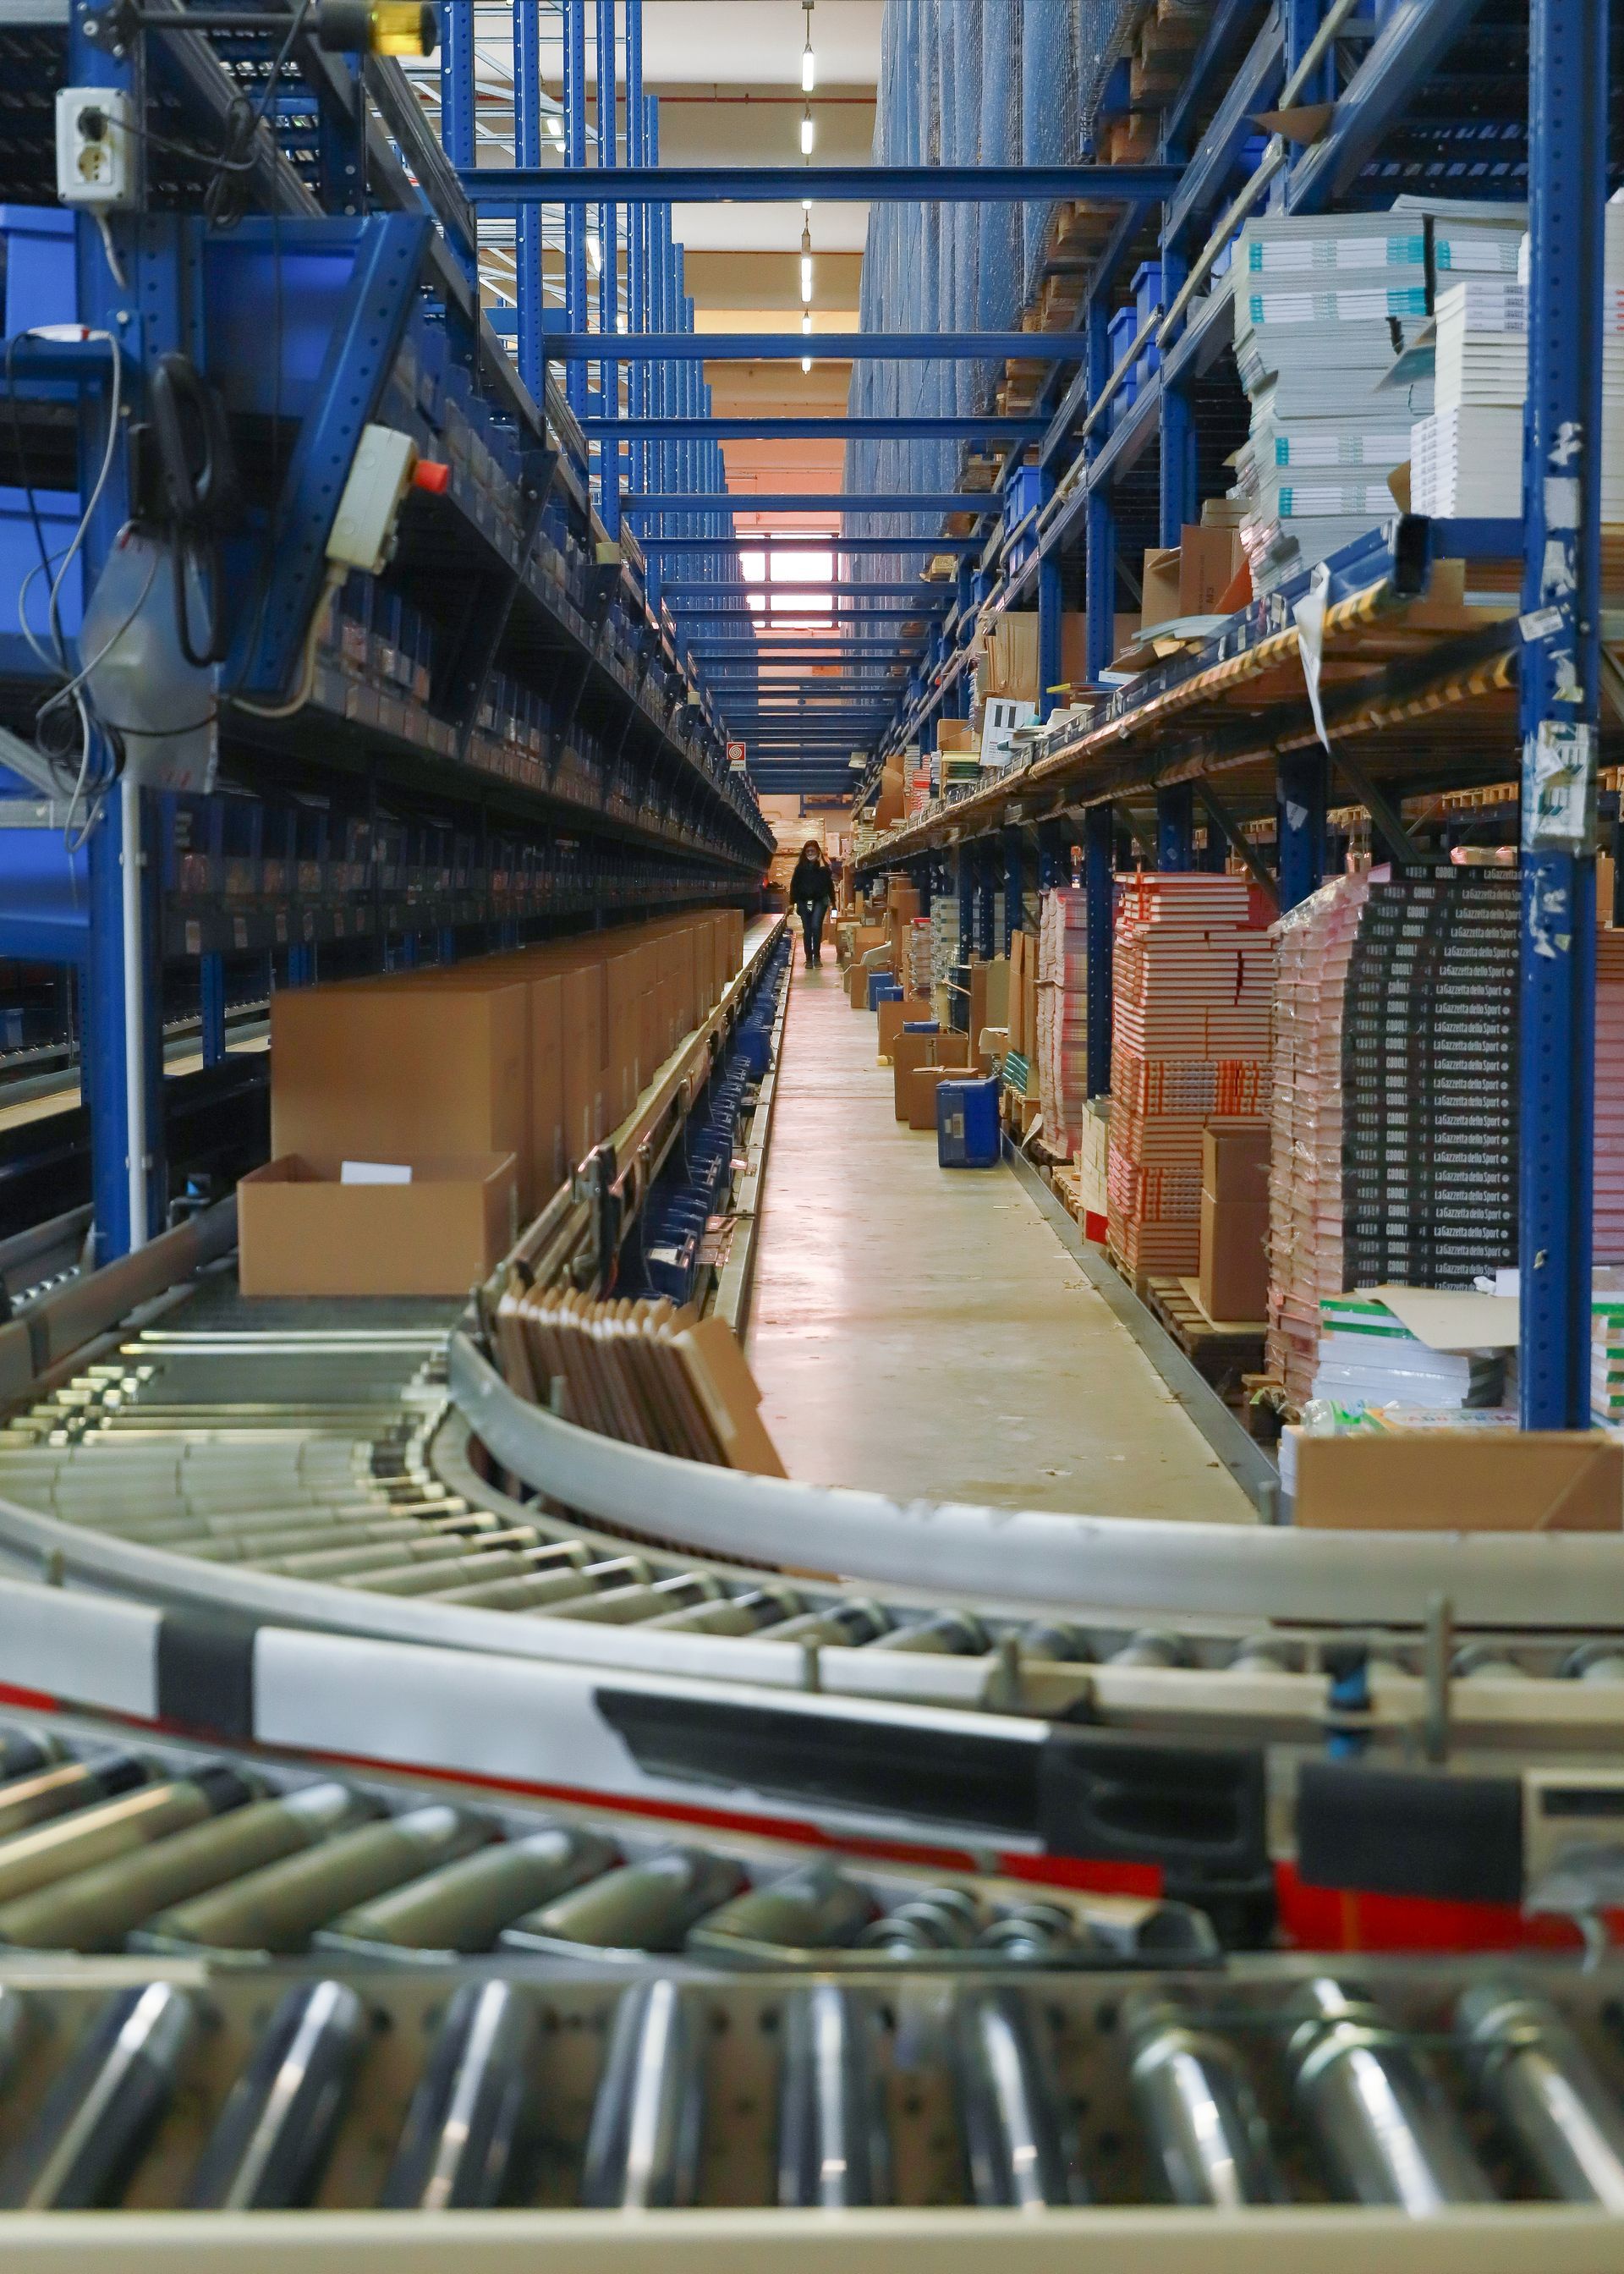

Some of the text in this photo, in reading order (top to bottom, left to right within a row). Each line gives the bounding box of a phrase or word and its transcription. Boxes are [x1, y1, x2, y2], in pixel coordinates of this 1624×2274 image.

[1499, 928, 1517, 940] Sport
[1492, 948, 1510, 958] Sport
[1488, 966, 1505, 978] Sport
[1484, 985, 1501, 997] Sport
[1484, 1004, 1501, 1016] Sport
[1483, 1023, 1500, 1035] Sport
[1482, 1041, 1499, 1052] Sport
[1482, 1060, 1500, 1072] Sport
[1482, 1079, 1499, 1090] Sport
[1482, 1096, 1500, 1108] Sport
[1483, 1116, 1501, 1127] Sport
[1483, 1134, 1500, 1145] Sport
[1482, 1153, 1499, 1165] Sport
[1483, 1172, 1501, 1184] Sport
[1483, 1191, 1500, 1202] Sport
[1484, 1209, 1501, 1220] Sport
[1482, 1228, 1499, 1239] Sport
[1484, 1246, 1501, 1258] Sport
